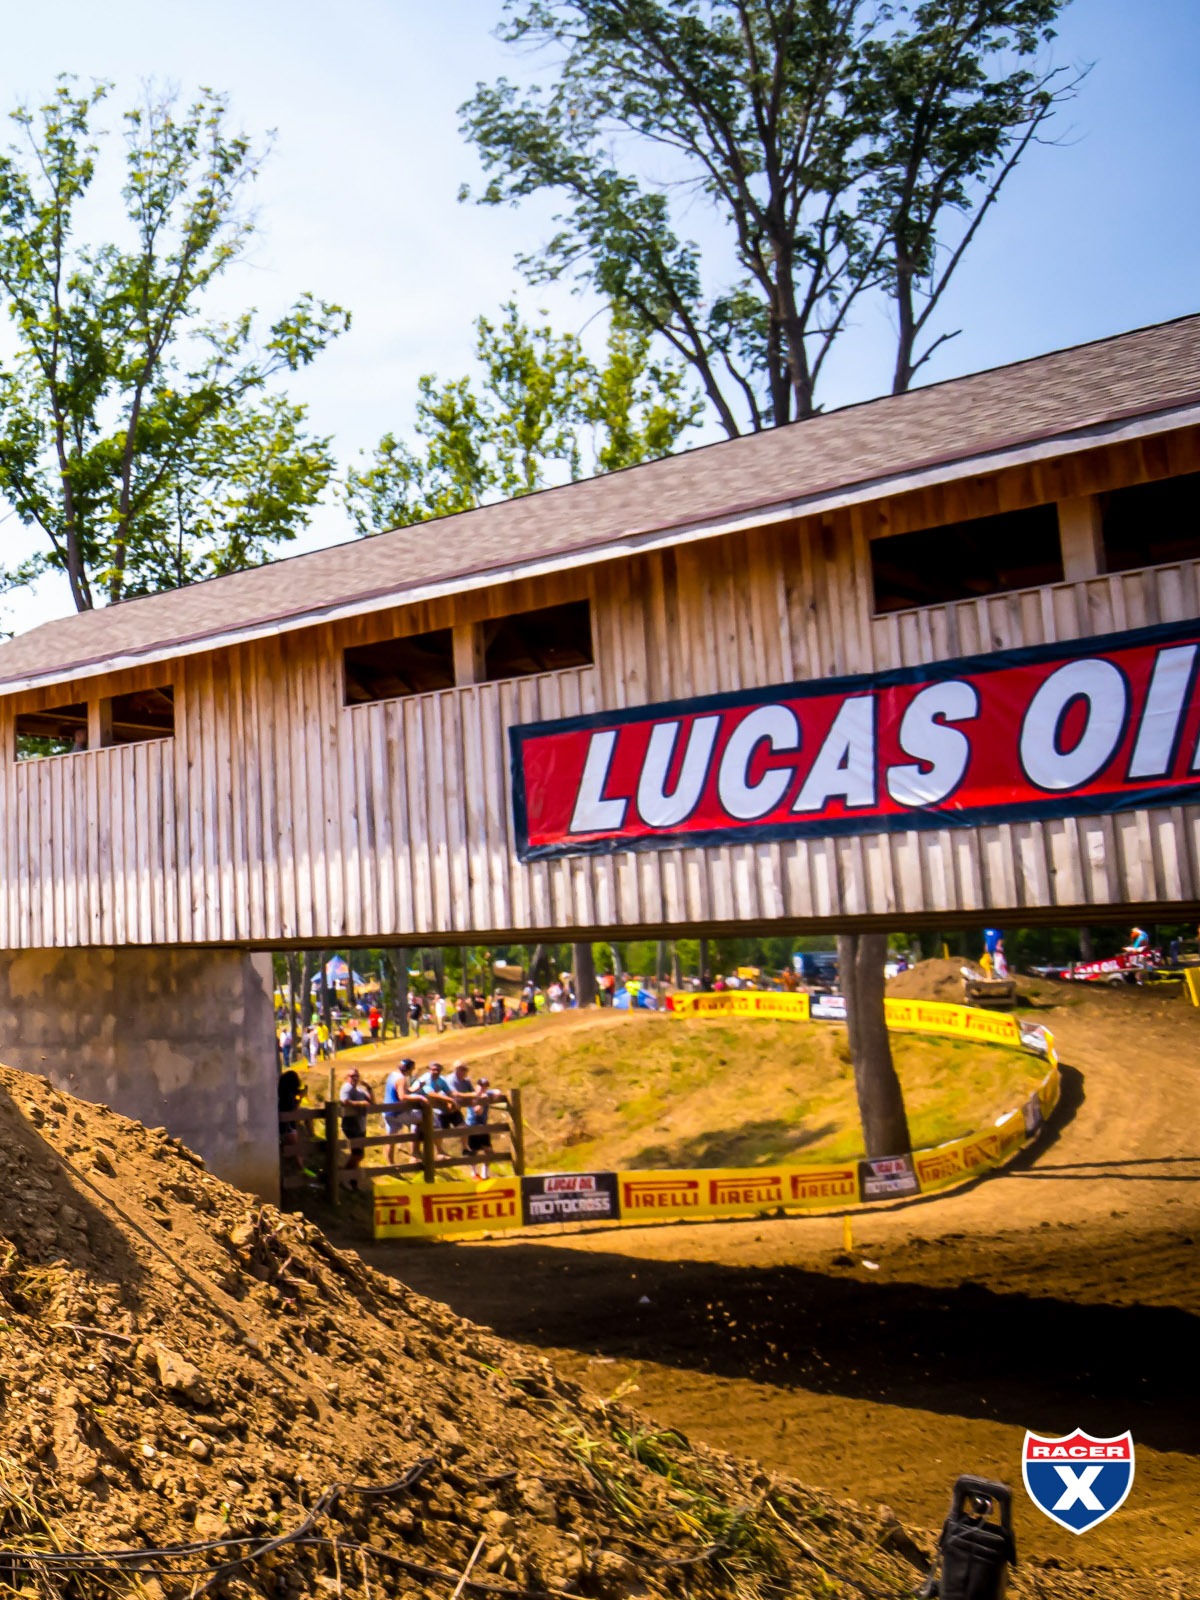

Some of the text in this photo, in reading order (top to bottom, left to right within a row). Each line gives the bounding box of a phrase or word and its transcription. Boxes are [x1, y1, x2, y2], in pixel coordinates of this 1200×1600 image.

[568, 643, 1200, 833] LUCAS OI
[624, 1180, 699, 1209] PIRELLI
[709, 1176, 782, 1206] PIRELLI
[790, 1171, 855, 1200] PIRELLI
[422, 1188, 516, 1224] PIRELLI
